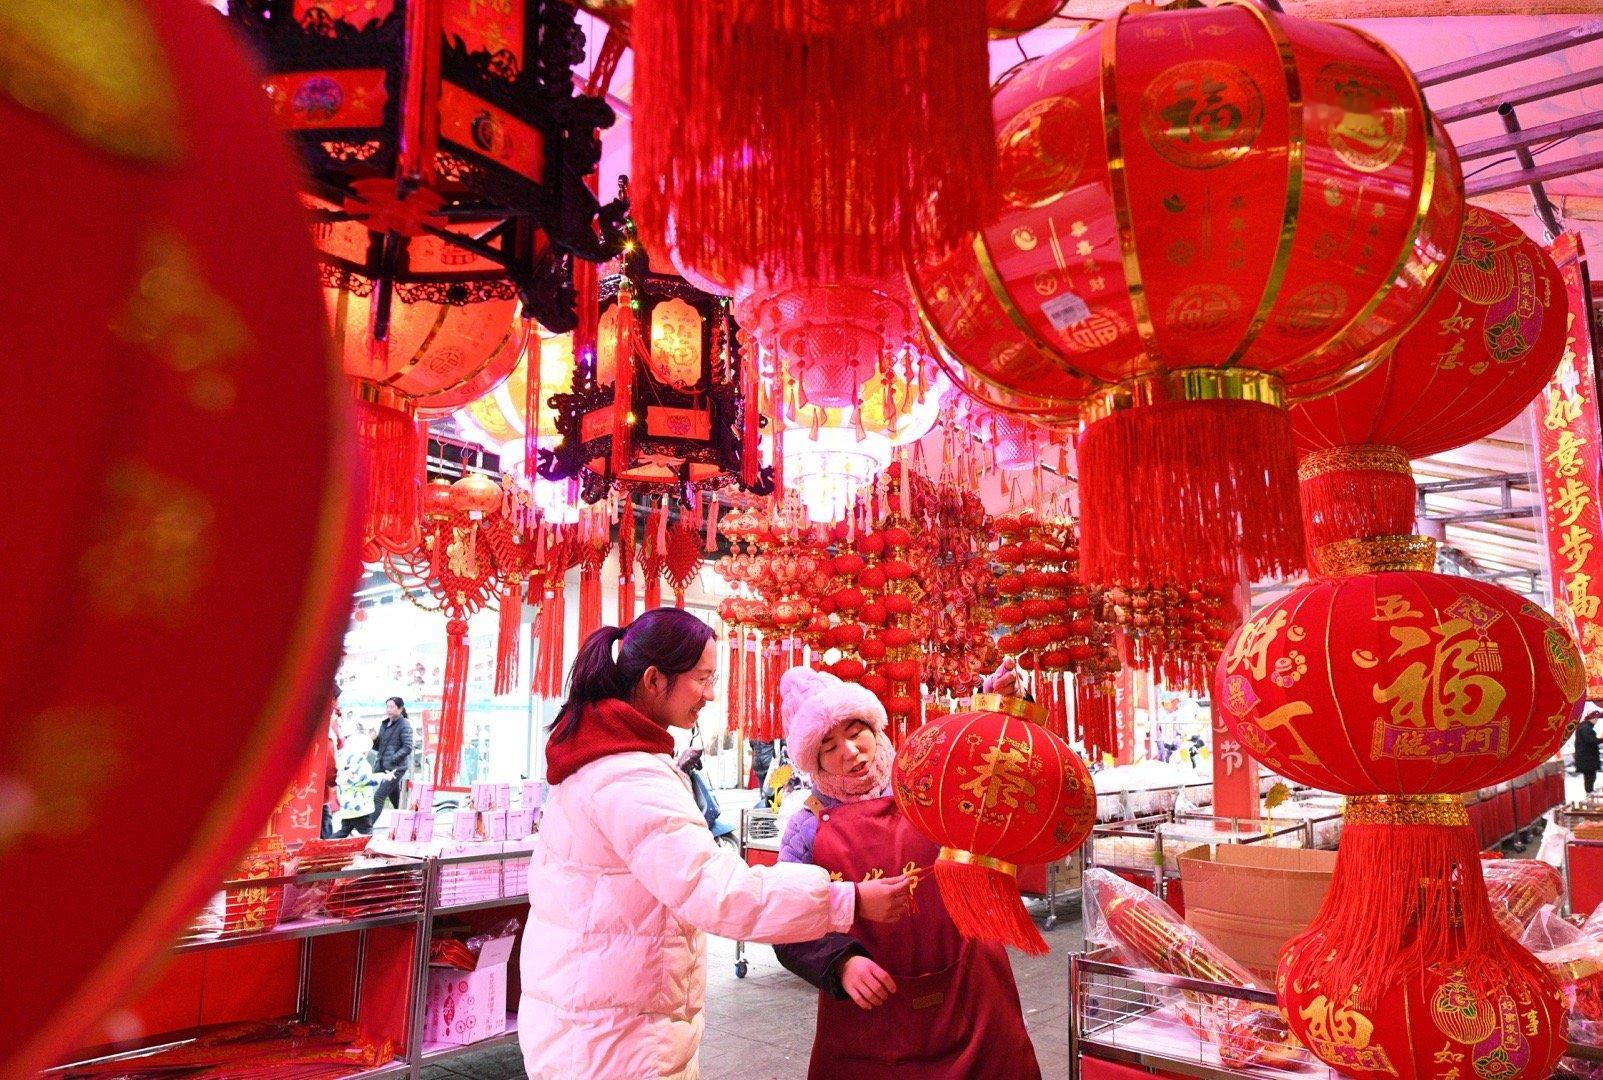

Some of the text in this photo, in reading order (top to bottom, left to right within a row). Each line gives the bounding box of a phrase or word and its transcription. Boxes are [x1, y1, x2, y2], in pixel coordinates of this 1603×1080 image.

[1161, 76, 1243, 144] 福
[1371, 594, 1424, 621] 五
[1372, 618, 1507, 731] 福
